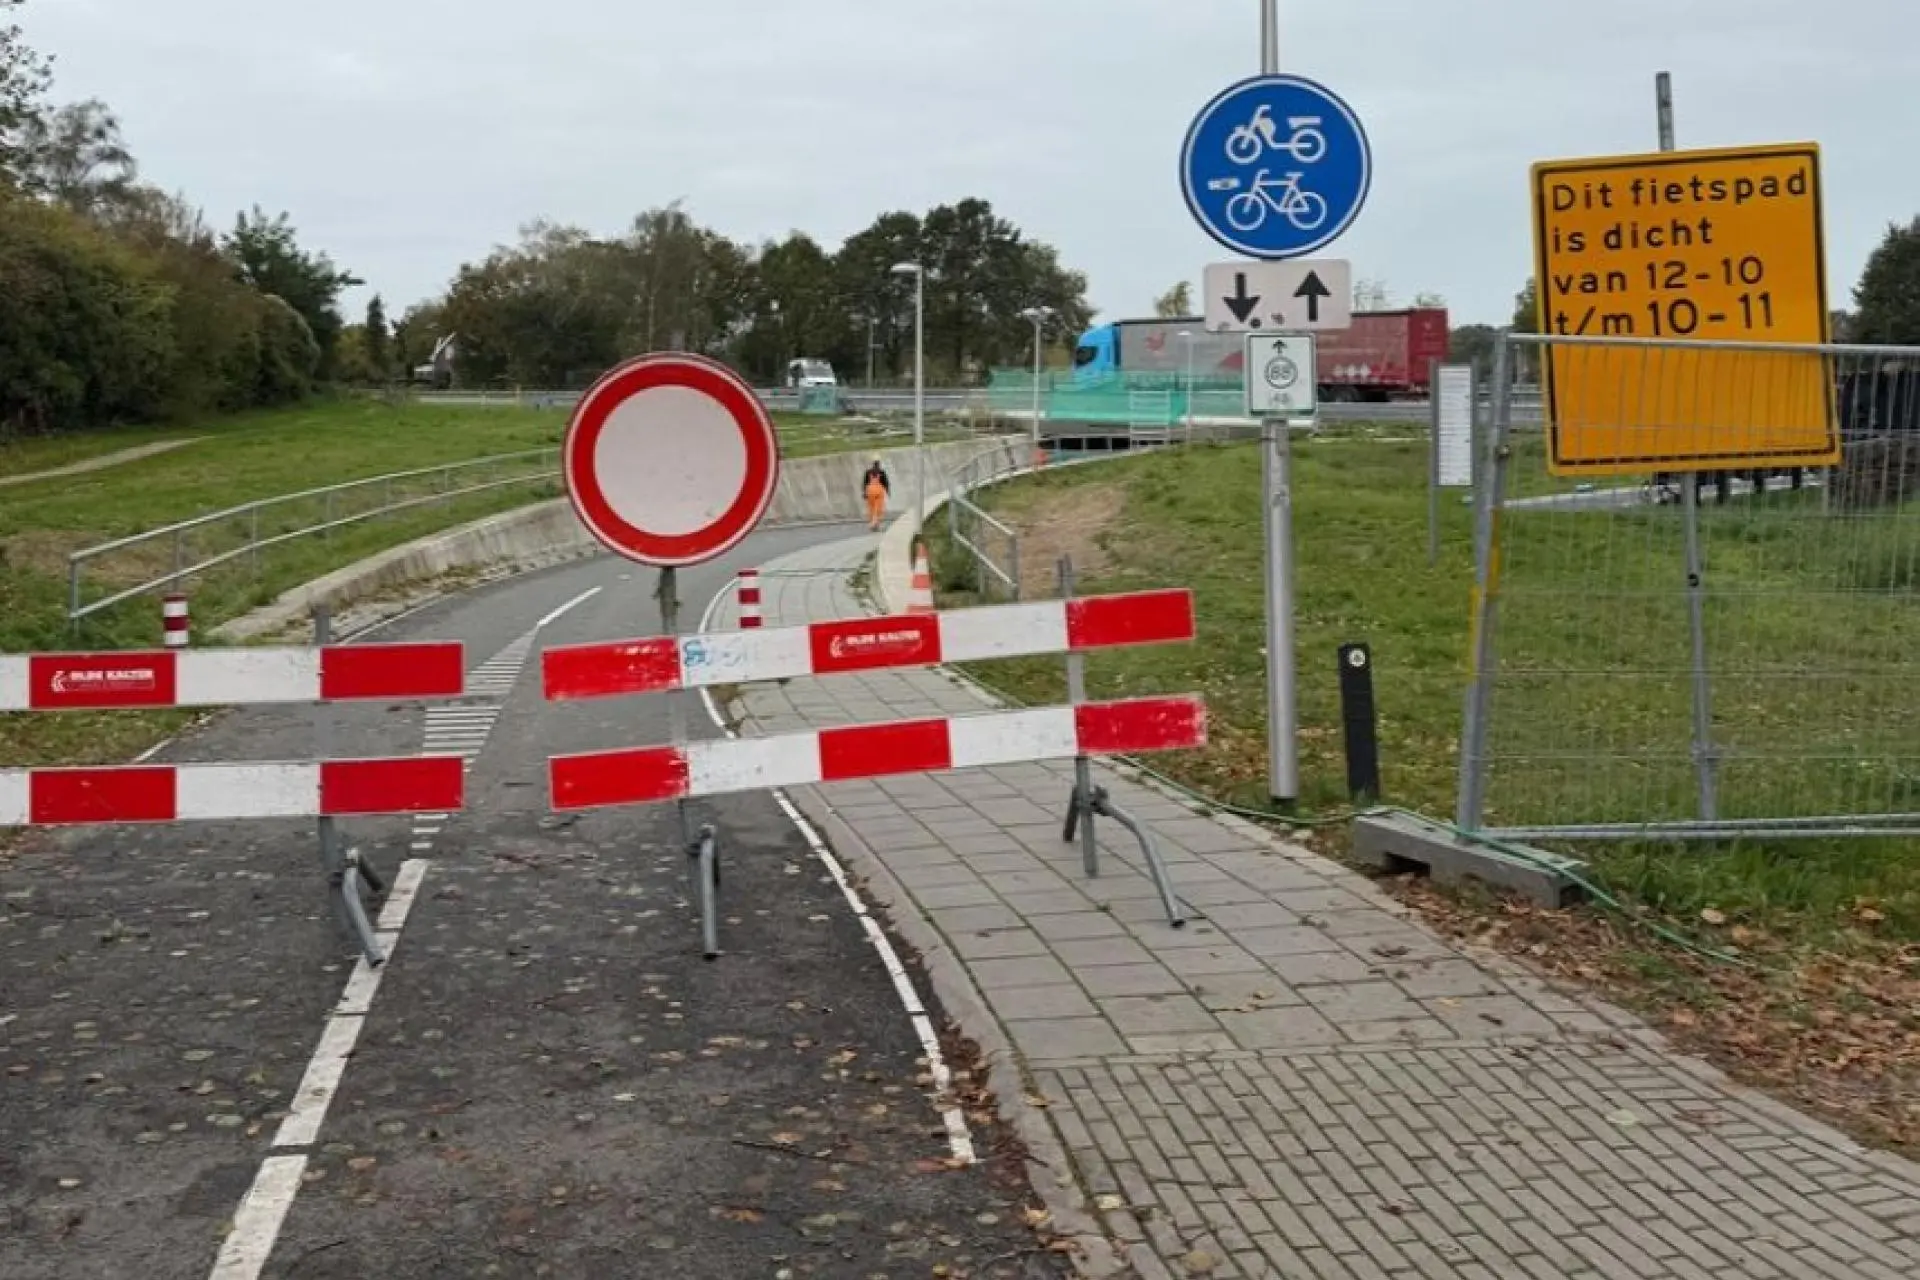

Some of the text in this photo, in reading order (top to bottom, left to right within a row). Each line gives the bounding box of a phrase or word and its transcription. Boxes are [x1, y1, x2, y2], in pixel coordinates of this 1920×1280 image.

[1552, 166, 1807, 211] Dit fietspad
[1553, 217, 1714, 253] is dicht
[1553, 256, 1764, 296] van 12-10
[1555, 292, 1774, 336] t/m 10-11
